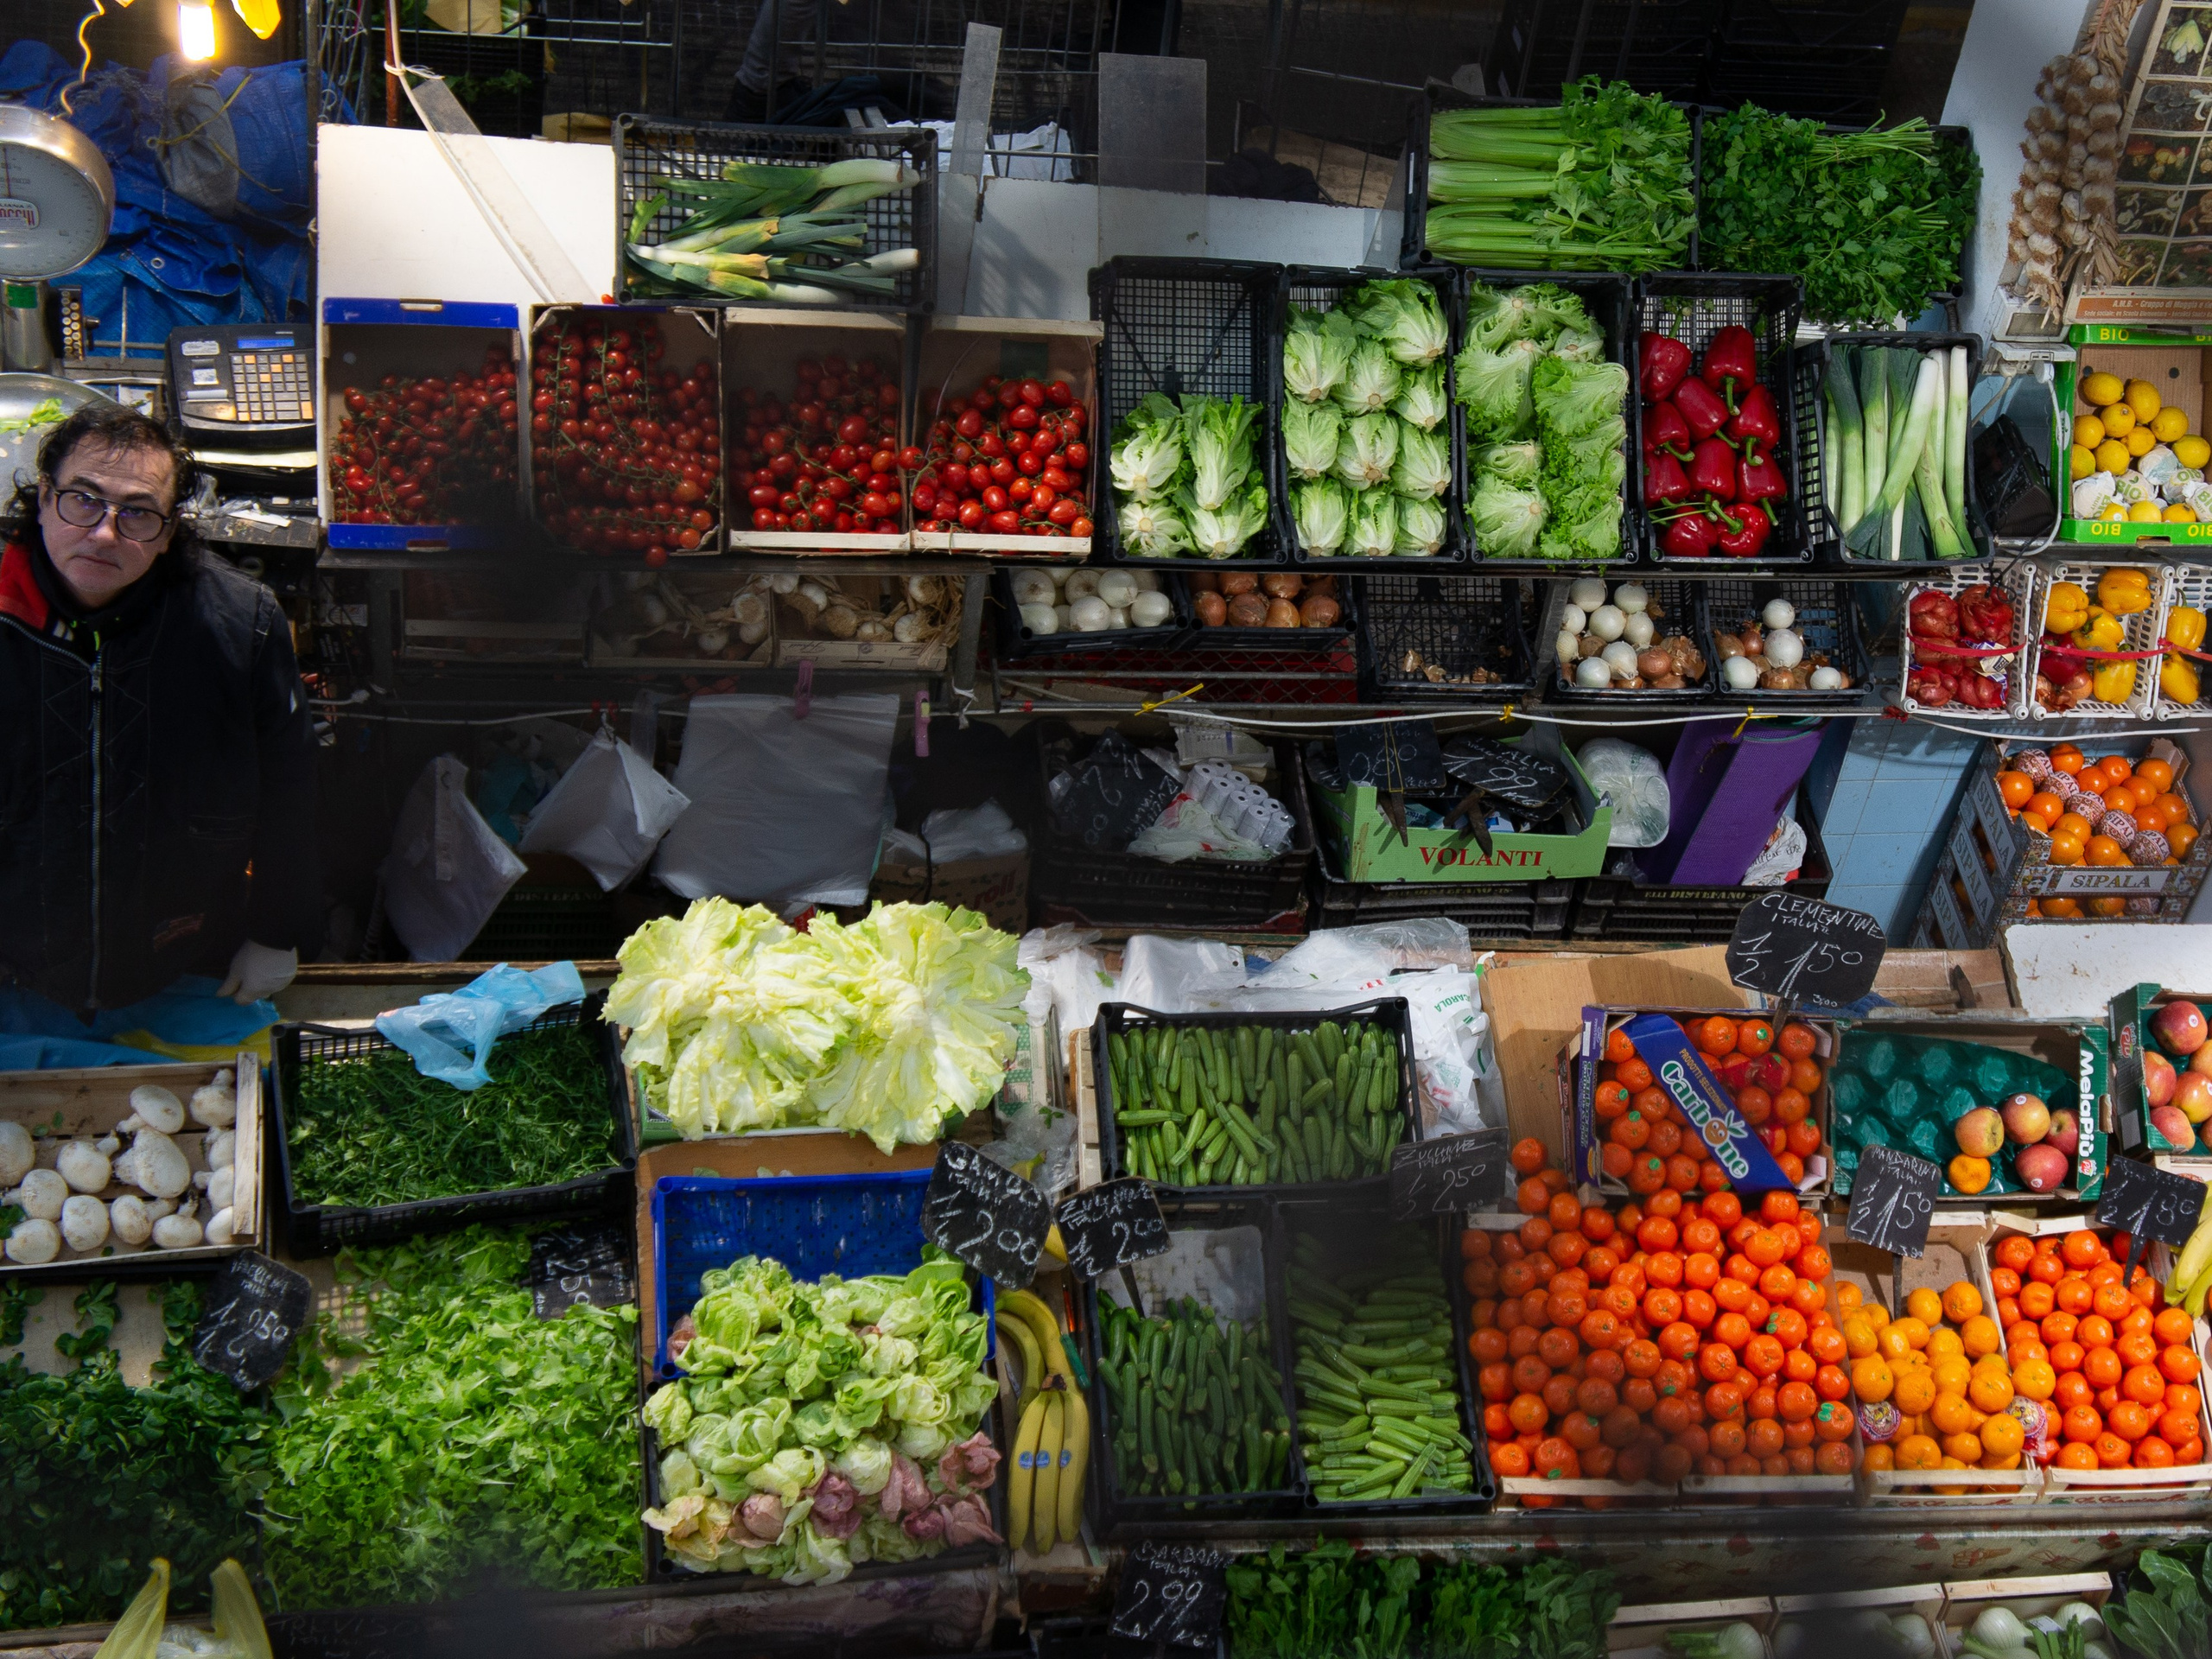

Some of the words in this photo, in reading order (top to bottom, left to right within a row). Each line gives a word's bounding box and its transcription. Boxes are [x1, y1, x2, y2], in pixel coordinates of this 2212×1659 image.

[2100, 327, 2129, 341] BIO
[2116, 479, 2142, 500] BIO
[2091, 522, 2121, 536] BIO
[1977, 780, 2012, 869] SIPALA
[2107, 812, 2134, 842] SIPAL
[1419, 846, 1544, 868] VOLANTI
[972, 868, 1017, 909] roll
[1955, 832, 1988, 918] SIPALA
[2069, 874, 2152, 889] SIPALA
[1669, 890, 1746, 899] DISTEFANO
[1761, 893, 1885, 939] CLEMENTINE
[1678, 1048, 1703, 1080] PRODOTTI
[1661, 1060, 1749, 1179] Carbone
[2079, 1049, 2094, 1158] MelaPiù
[1872, 1147, 1936, 1182] MANDARINI
